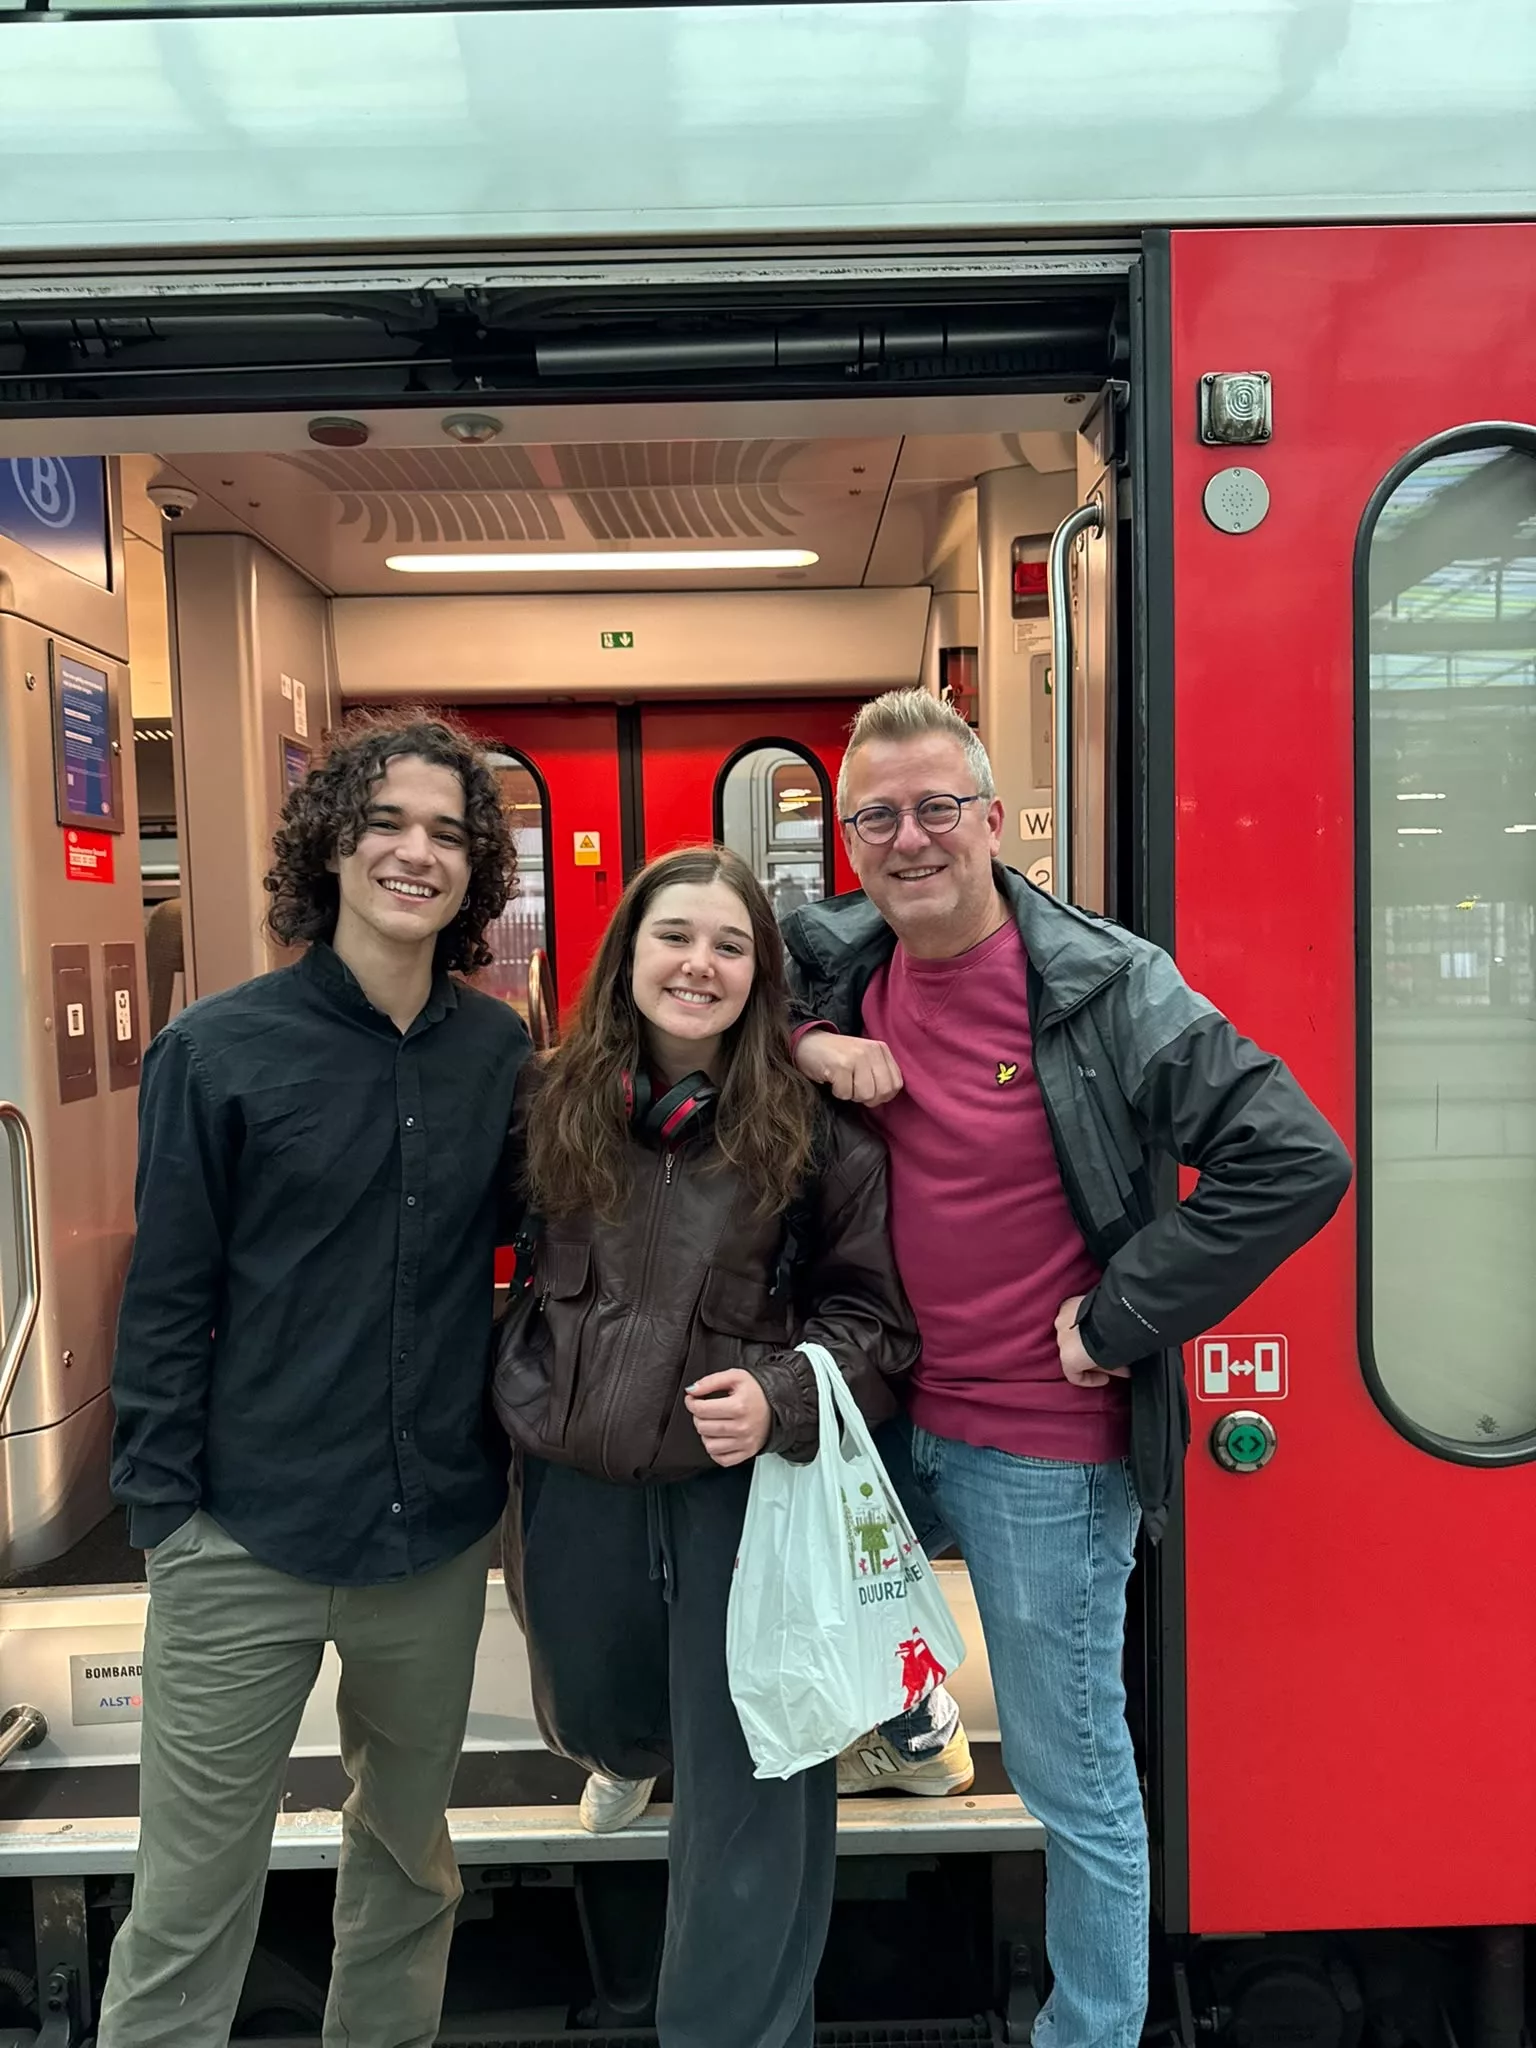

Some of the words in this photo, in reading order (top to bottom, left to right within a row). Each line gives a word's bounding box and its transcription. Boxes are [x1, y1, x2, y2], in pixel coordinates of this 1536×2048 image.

[30, 456, 60, 514] B
[1025, 811, 1052, 835] W
[85, 1665, 143, 1679] BOMBARD
[99, 1695, 142, 1708] ALSTO
[857, 1745, 900, 1777] N
